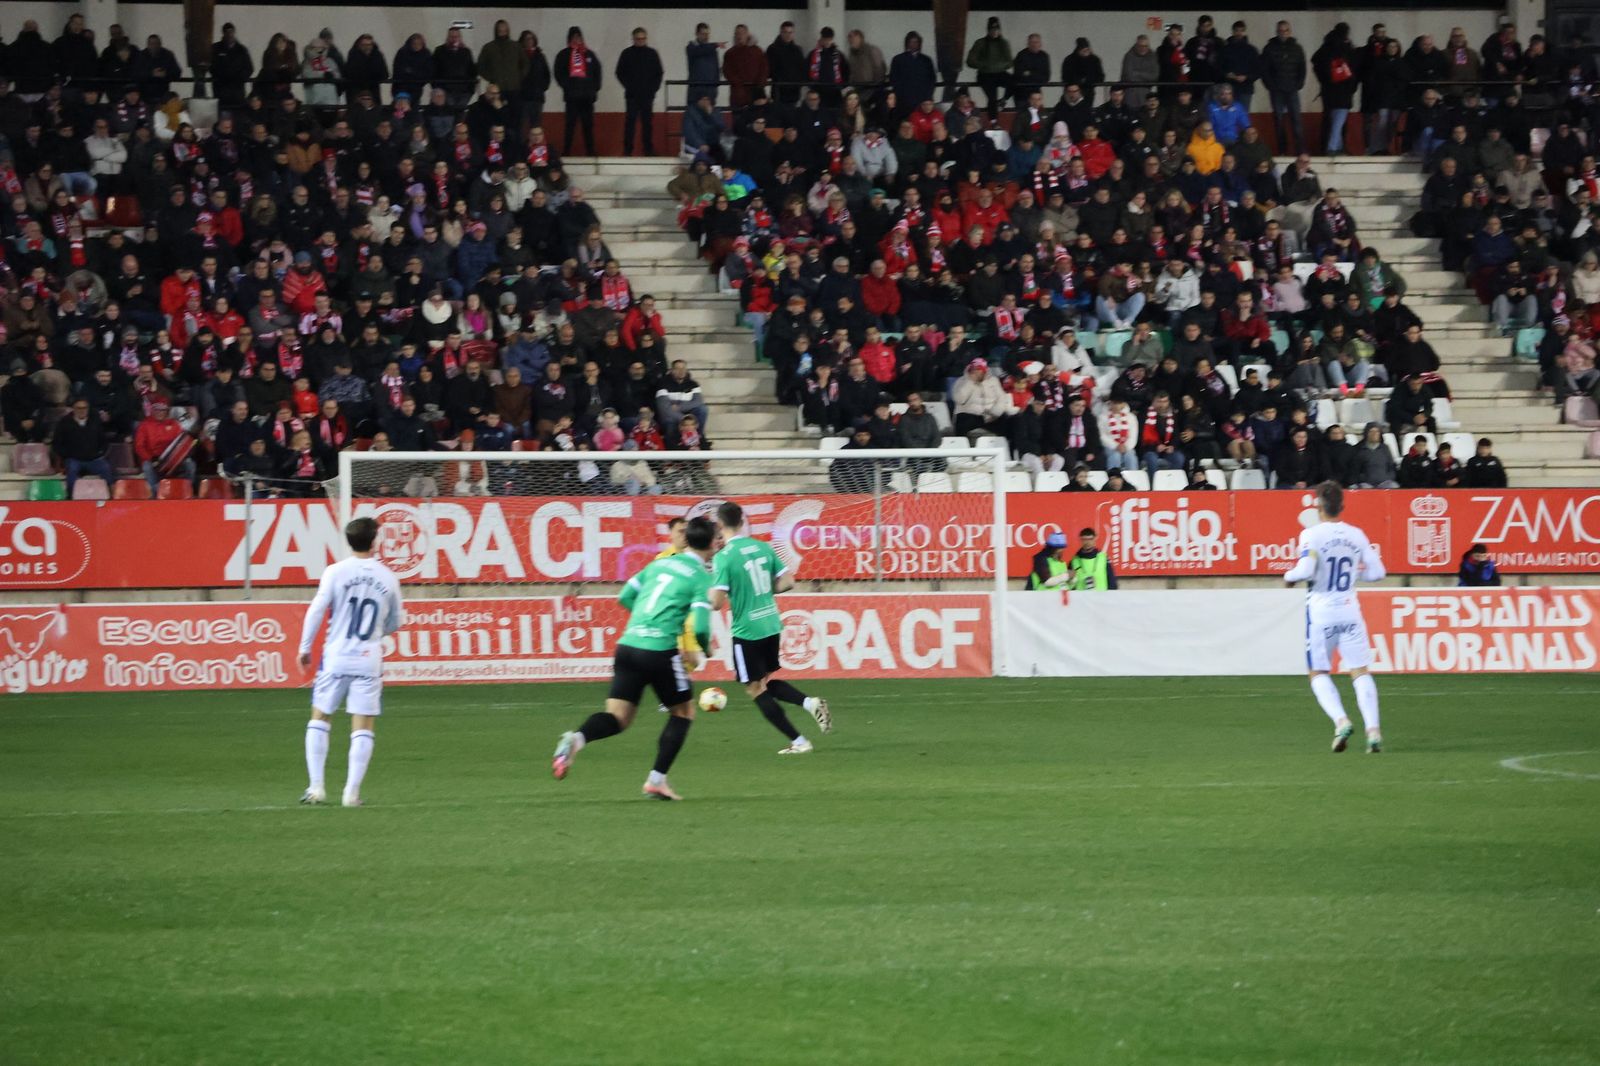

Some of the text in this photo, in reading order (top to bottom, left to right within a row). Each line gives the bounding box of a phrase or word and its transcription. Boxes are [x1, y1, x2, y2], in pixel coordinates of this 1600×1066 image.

[529, 501, 632, 578] CF
[796, 524, 931, 550] CENTRO
[855, 550, 998, 575] ROBERTO
[1325, 556, 1353, 592] 16
[1486, 552, 1600, 567] UNTAMIENTO
[98, 611, 287, 646] Escuela
[346, 596, 379, 641] 10
[402, 608, 494, 629] bodegas
[900, 607, 981, 670] CF
[1338, 631, 1598, 672] AMORANAS
[102, 650, 289, 688] infantil
